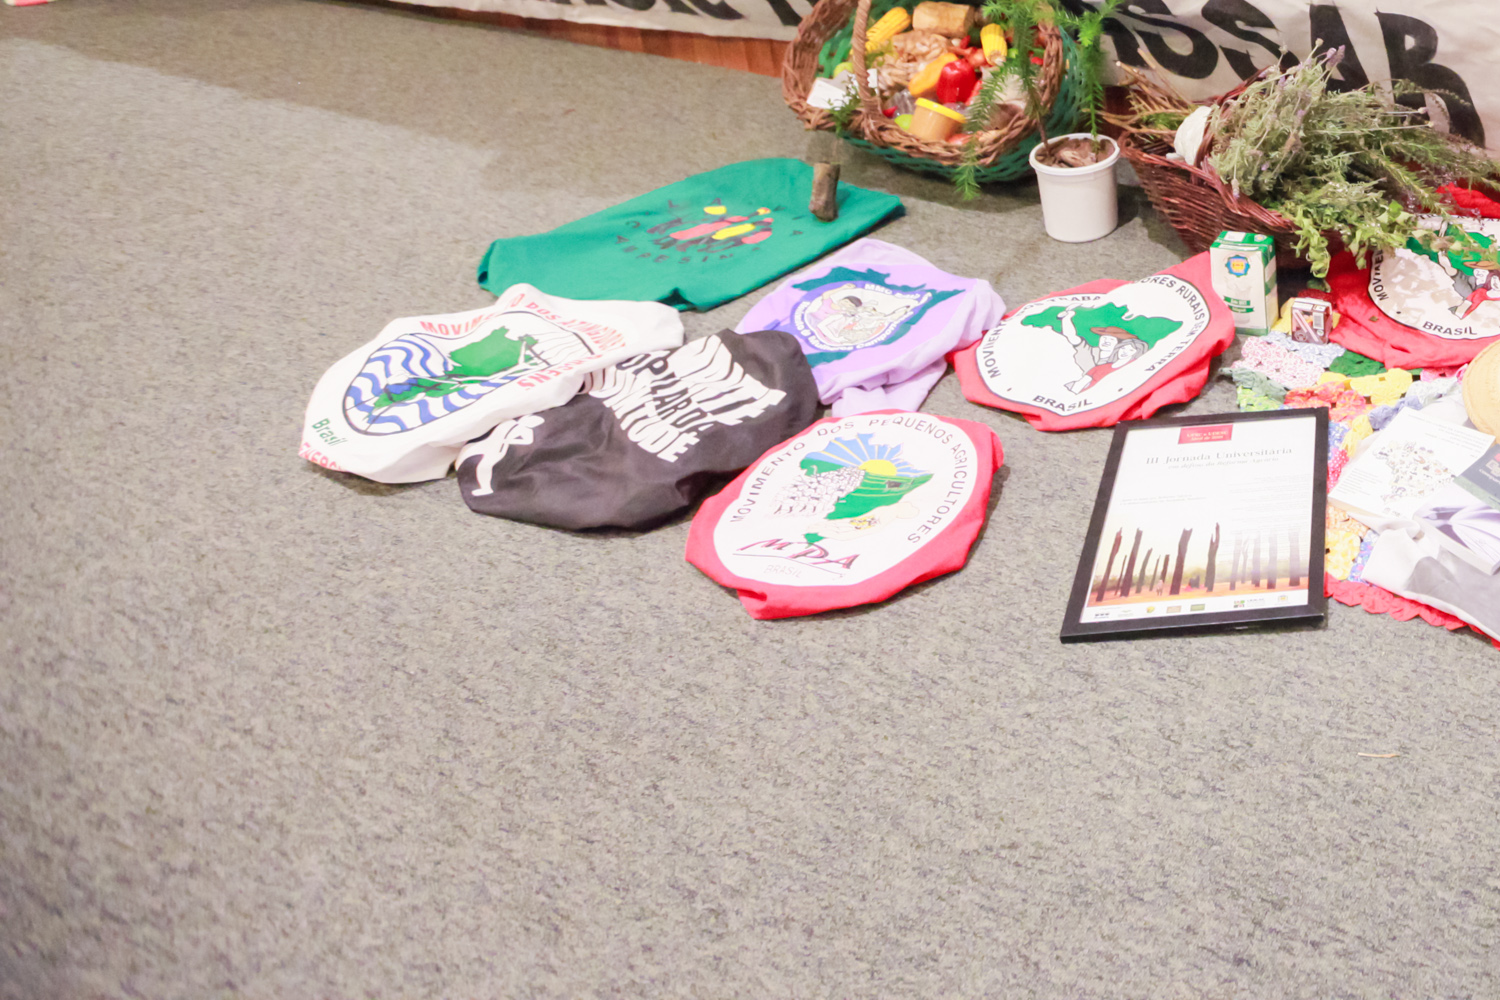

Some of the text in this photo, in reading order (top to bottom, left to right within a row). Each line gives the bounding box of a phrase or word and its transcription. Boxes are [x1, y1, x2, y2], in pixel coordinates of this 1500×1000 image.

[1175, 284, 1206, 321] RURAIS
[1422, 320, 1478, 337] BRASIL
[1144, 338, 1192, 372] TERRA
[1032, 394, 1094, 413] BRASIL
[1163, 453, 1211, 465] Jornada
[1216, 447, 1293, 460] Universitária
[729, 415, 969, 544] MOVIMENTO DOS PEQUENOS AGRICULTORES
[736, 537, 861, 571] MPA
